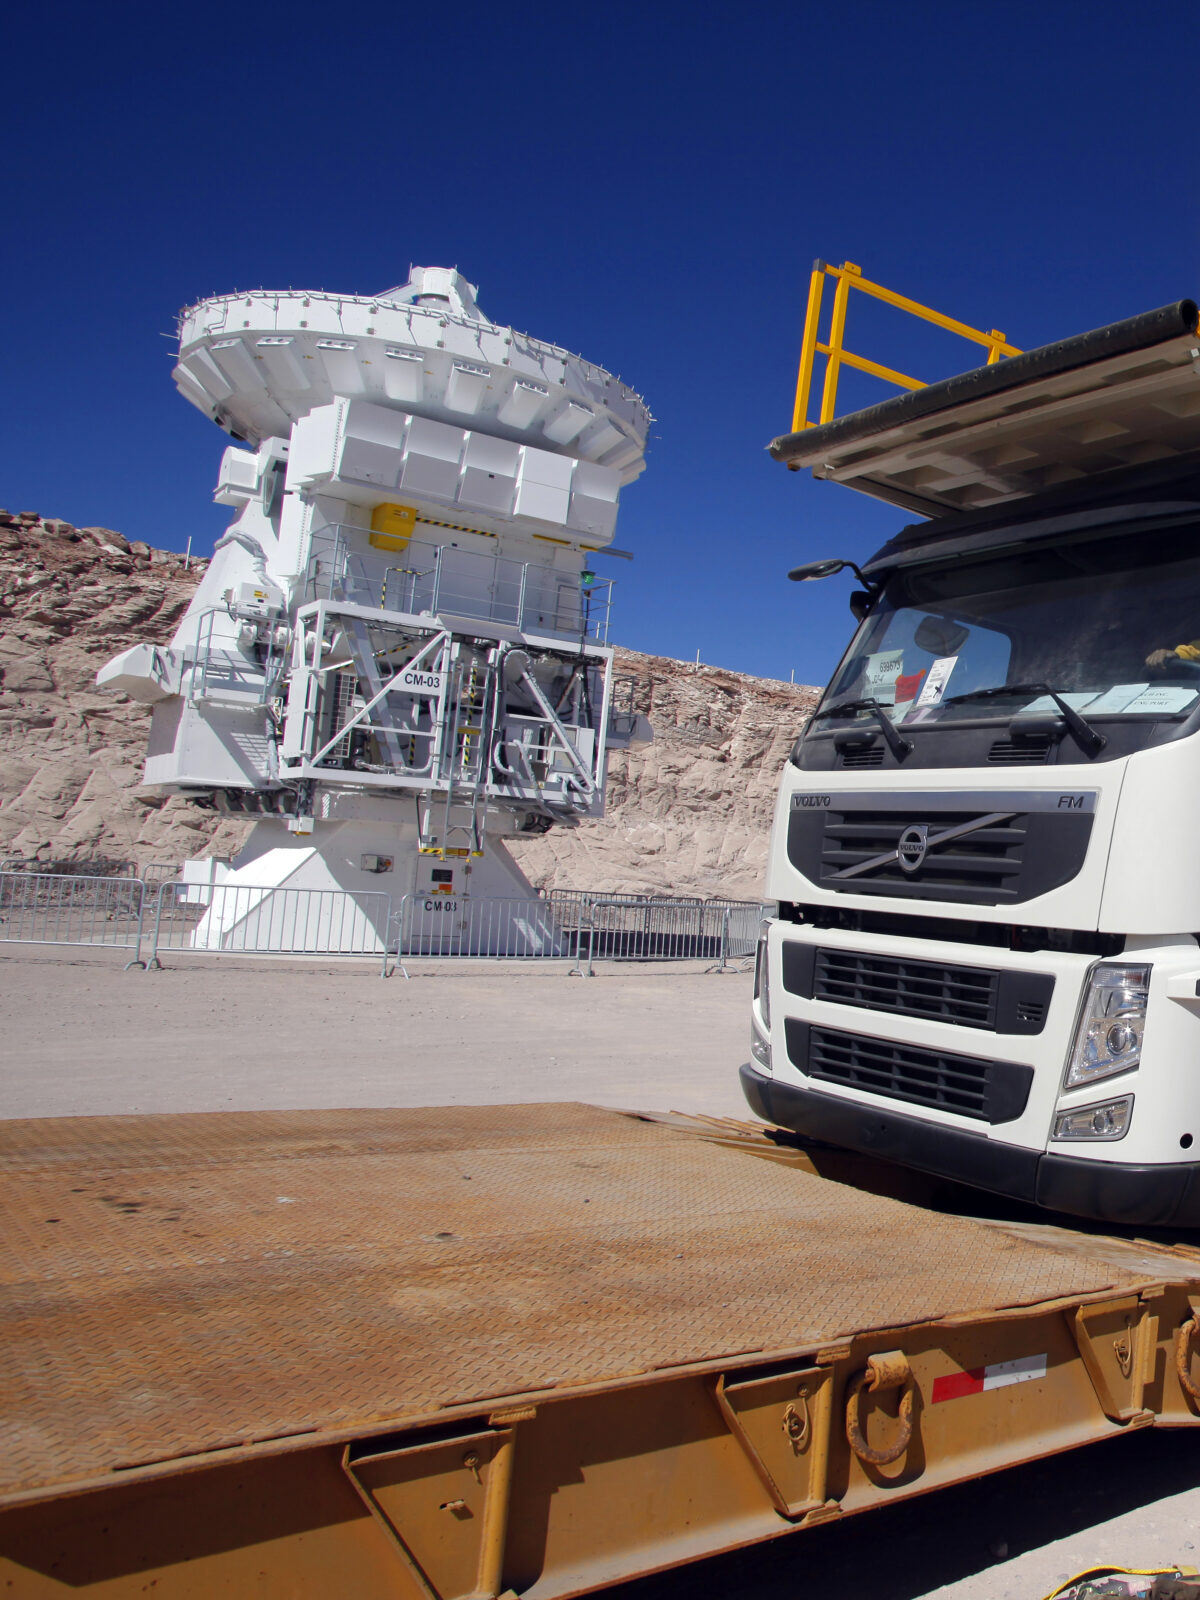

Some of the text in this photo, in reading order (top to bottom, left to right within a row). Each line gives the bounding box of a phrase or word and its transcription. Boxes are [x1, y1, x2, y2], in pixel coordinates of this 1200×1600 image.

[404, 673, 440, 689] CM-03
[794, 795, 831, 807] VOLVO
[1057, 795, 1085, 809] FM
[900, 844, 924, 852] VOLVO
